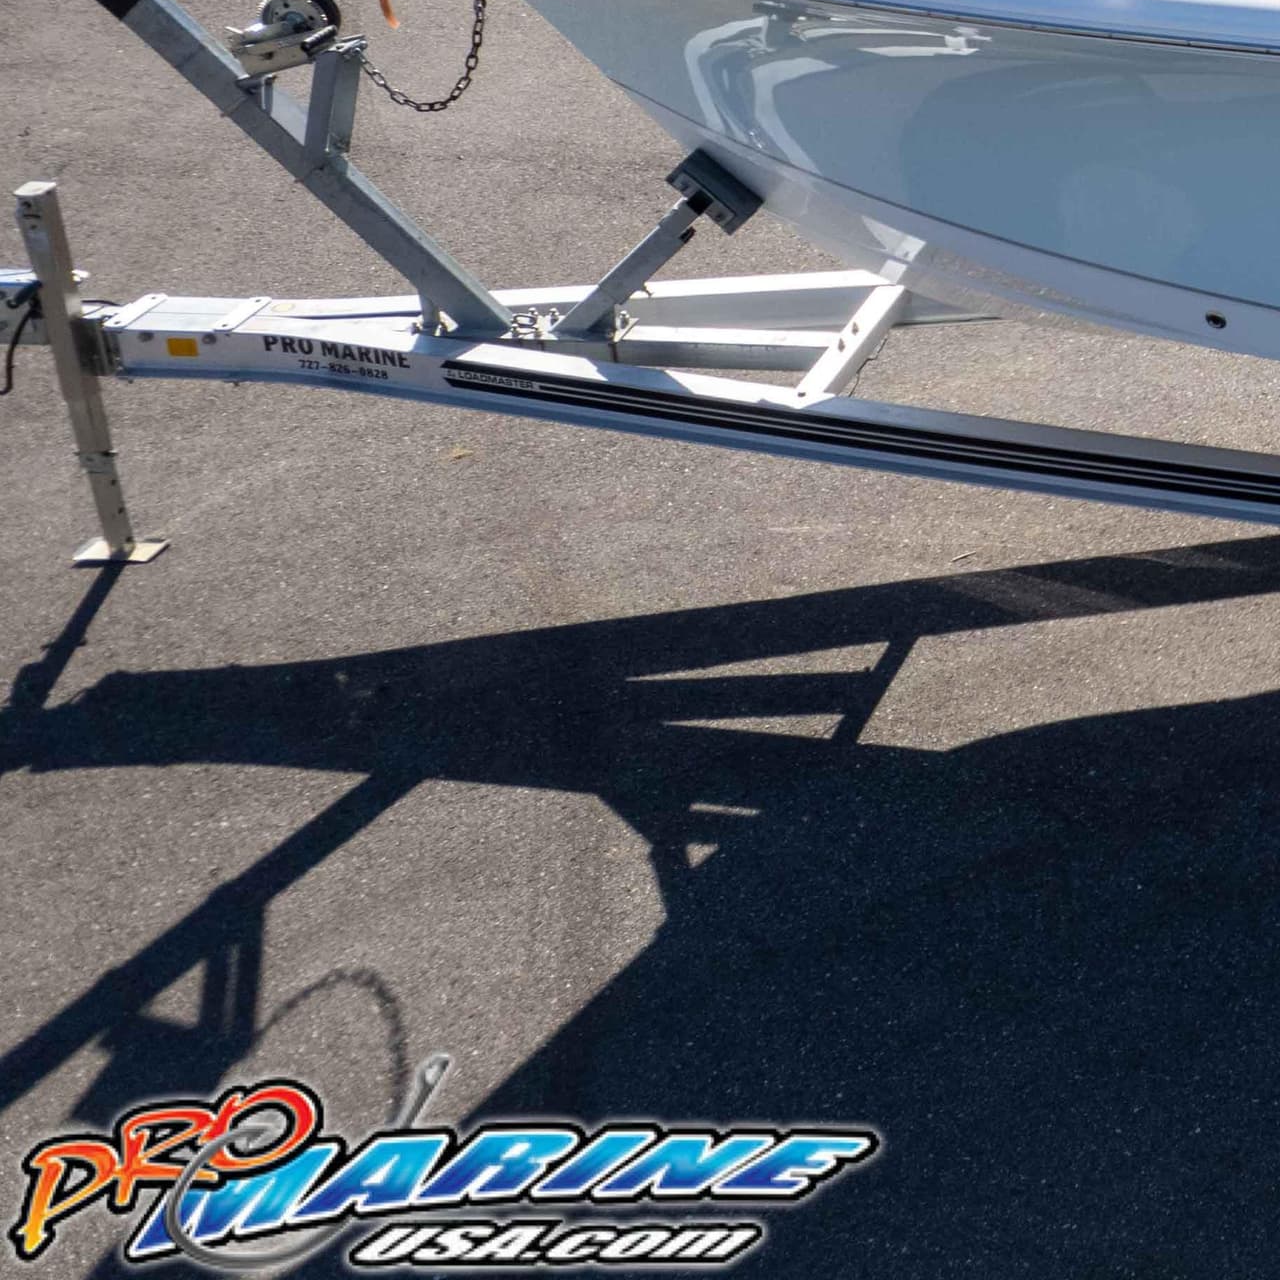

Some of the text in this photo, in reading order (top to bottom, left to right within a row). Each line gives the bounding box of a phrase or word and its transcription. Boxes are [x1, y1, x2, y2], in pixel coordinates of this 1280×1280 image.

[263, 335, 411, 369] PRO MARINE
[459, 370, 533, 389] LOADMASTER
